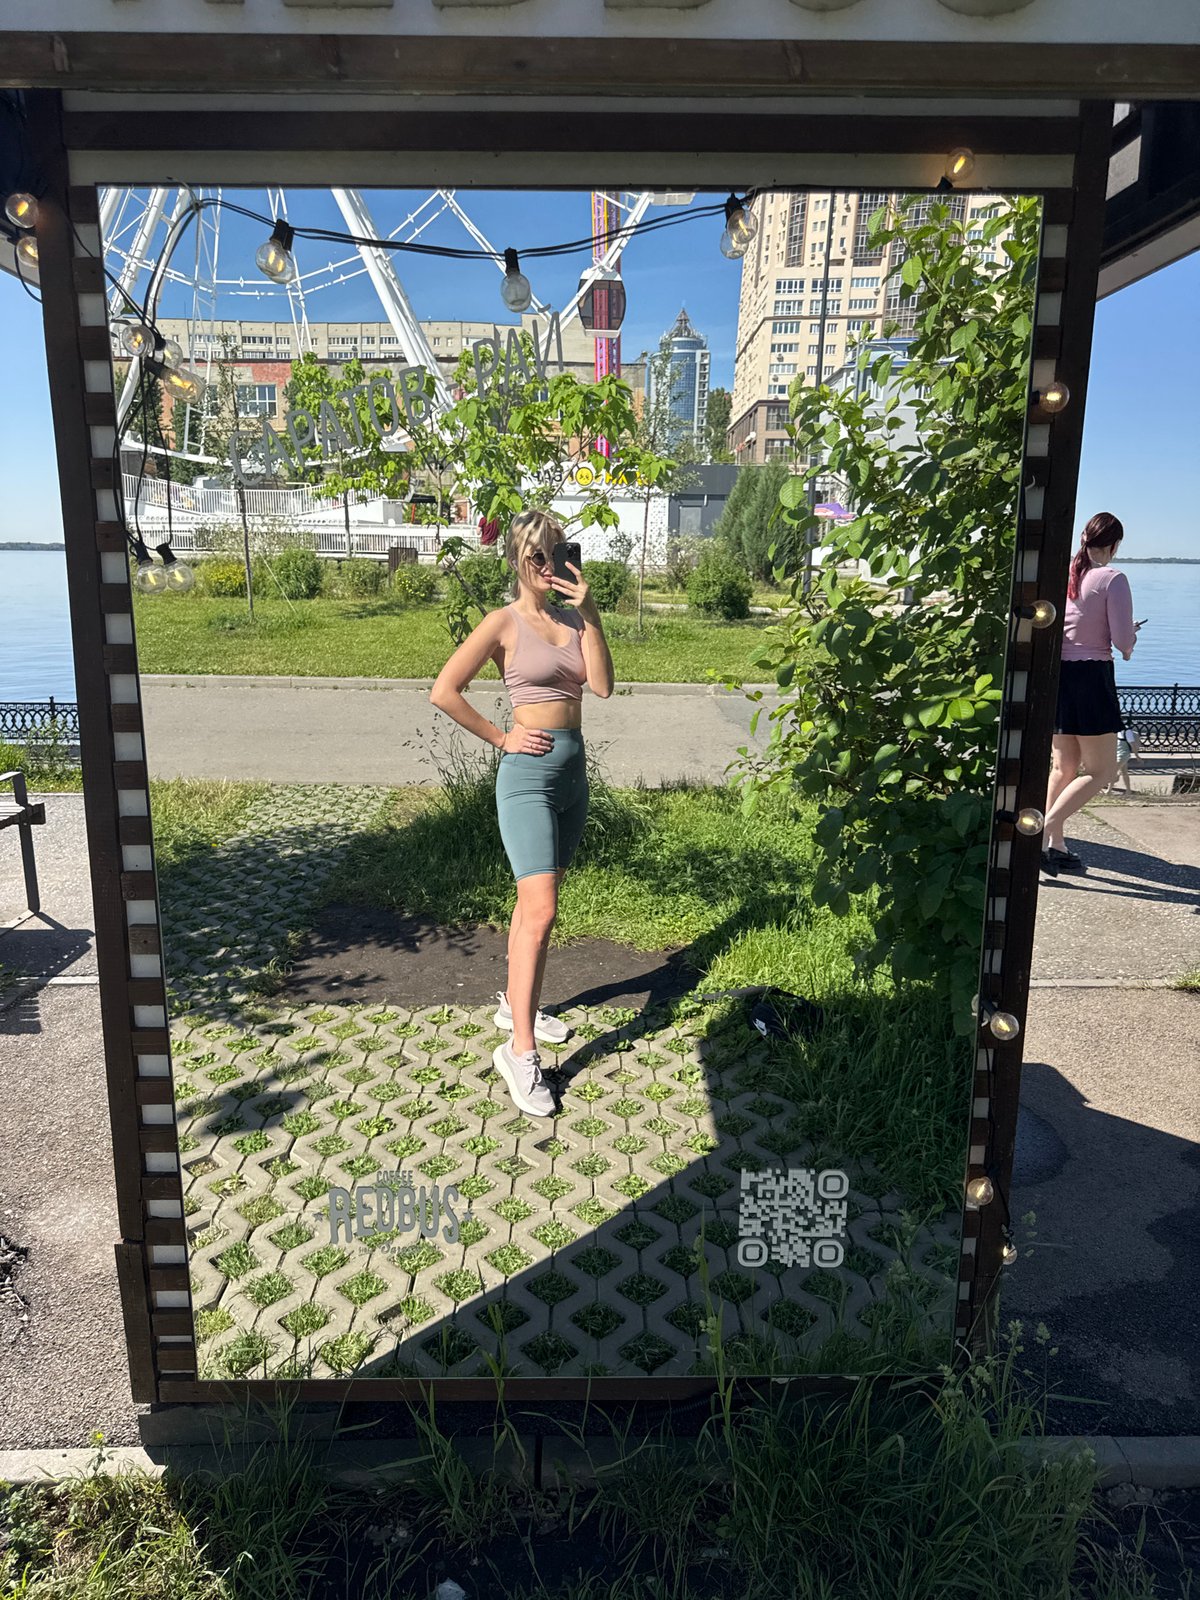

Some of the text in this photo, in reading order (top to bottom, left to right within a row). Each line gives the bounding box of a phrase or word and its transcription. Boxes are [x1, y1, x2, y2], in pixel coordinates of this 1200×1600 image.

[229, 366, 431, 486] САРАТОВ
[472, 302, 564, 399] РАЙ
[376, 1170, 414, 1186] COFFEE
[328, 1186, 460, 1245] REDBUS
